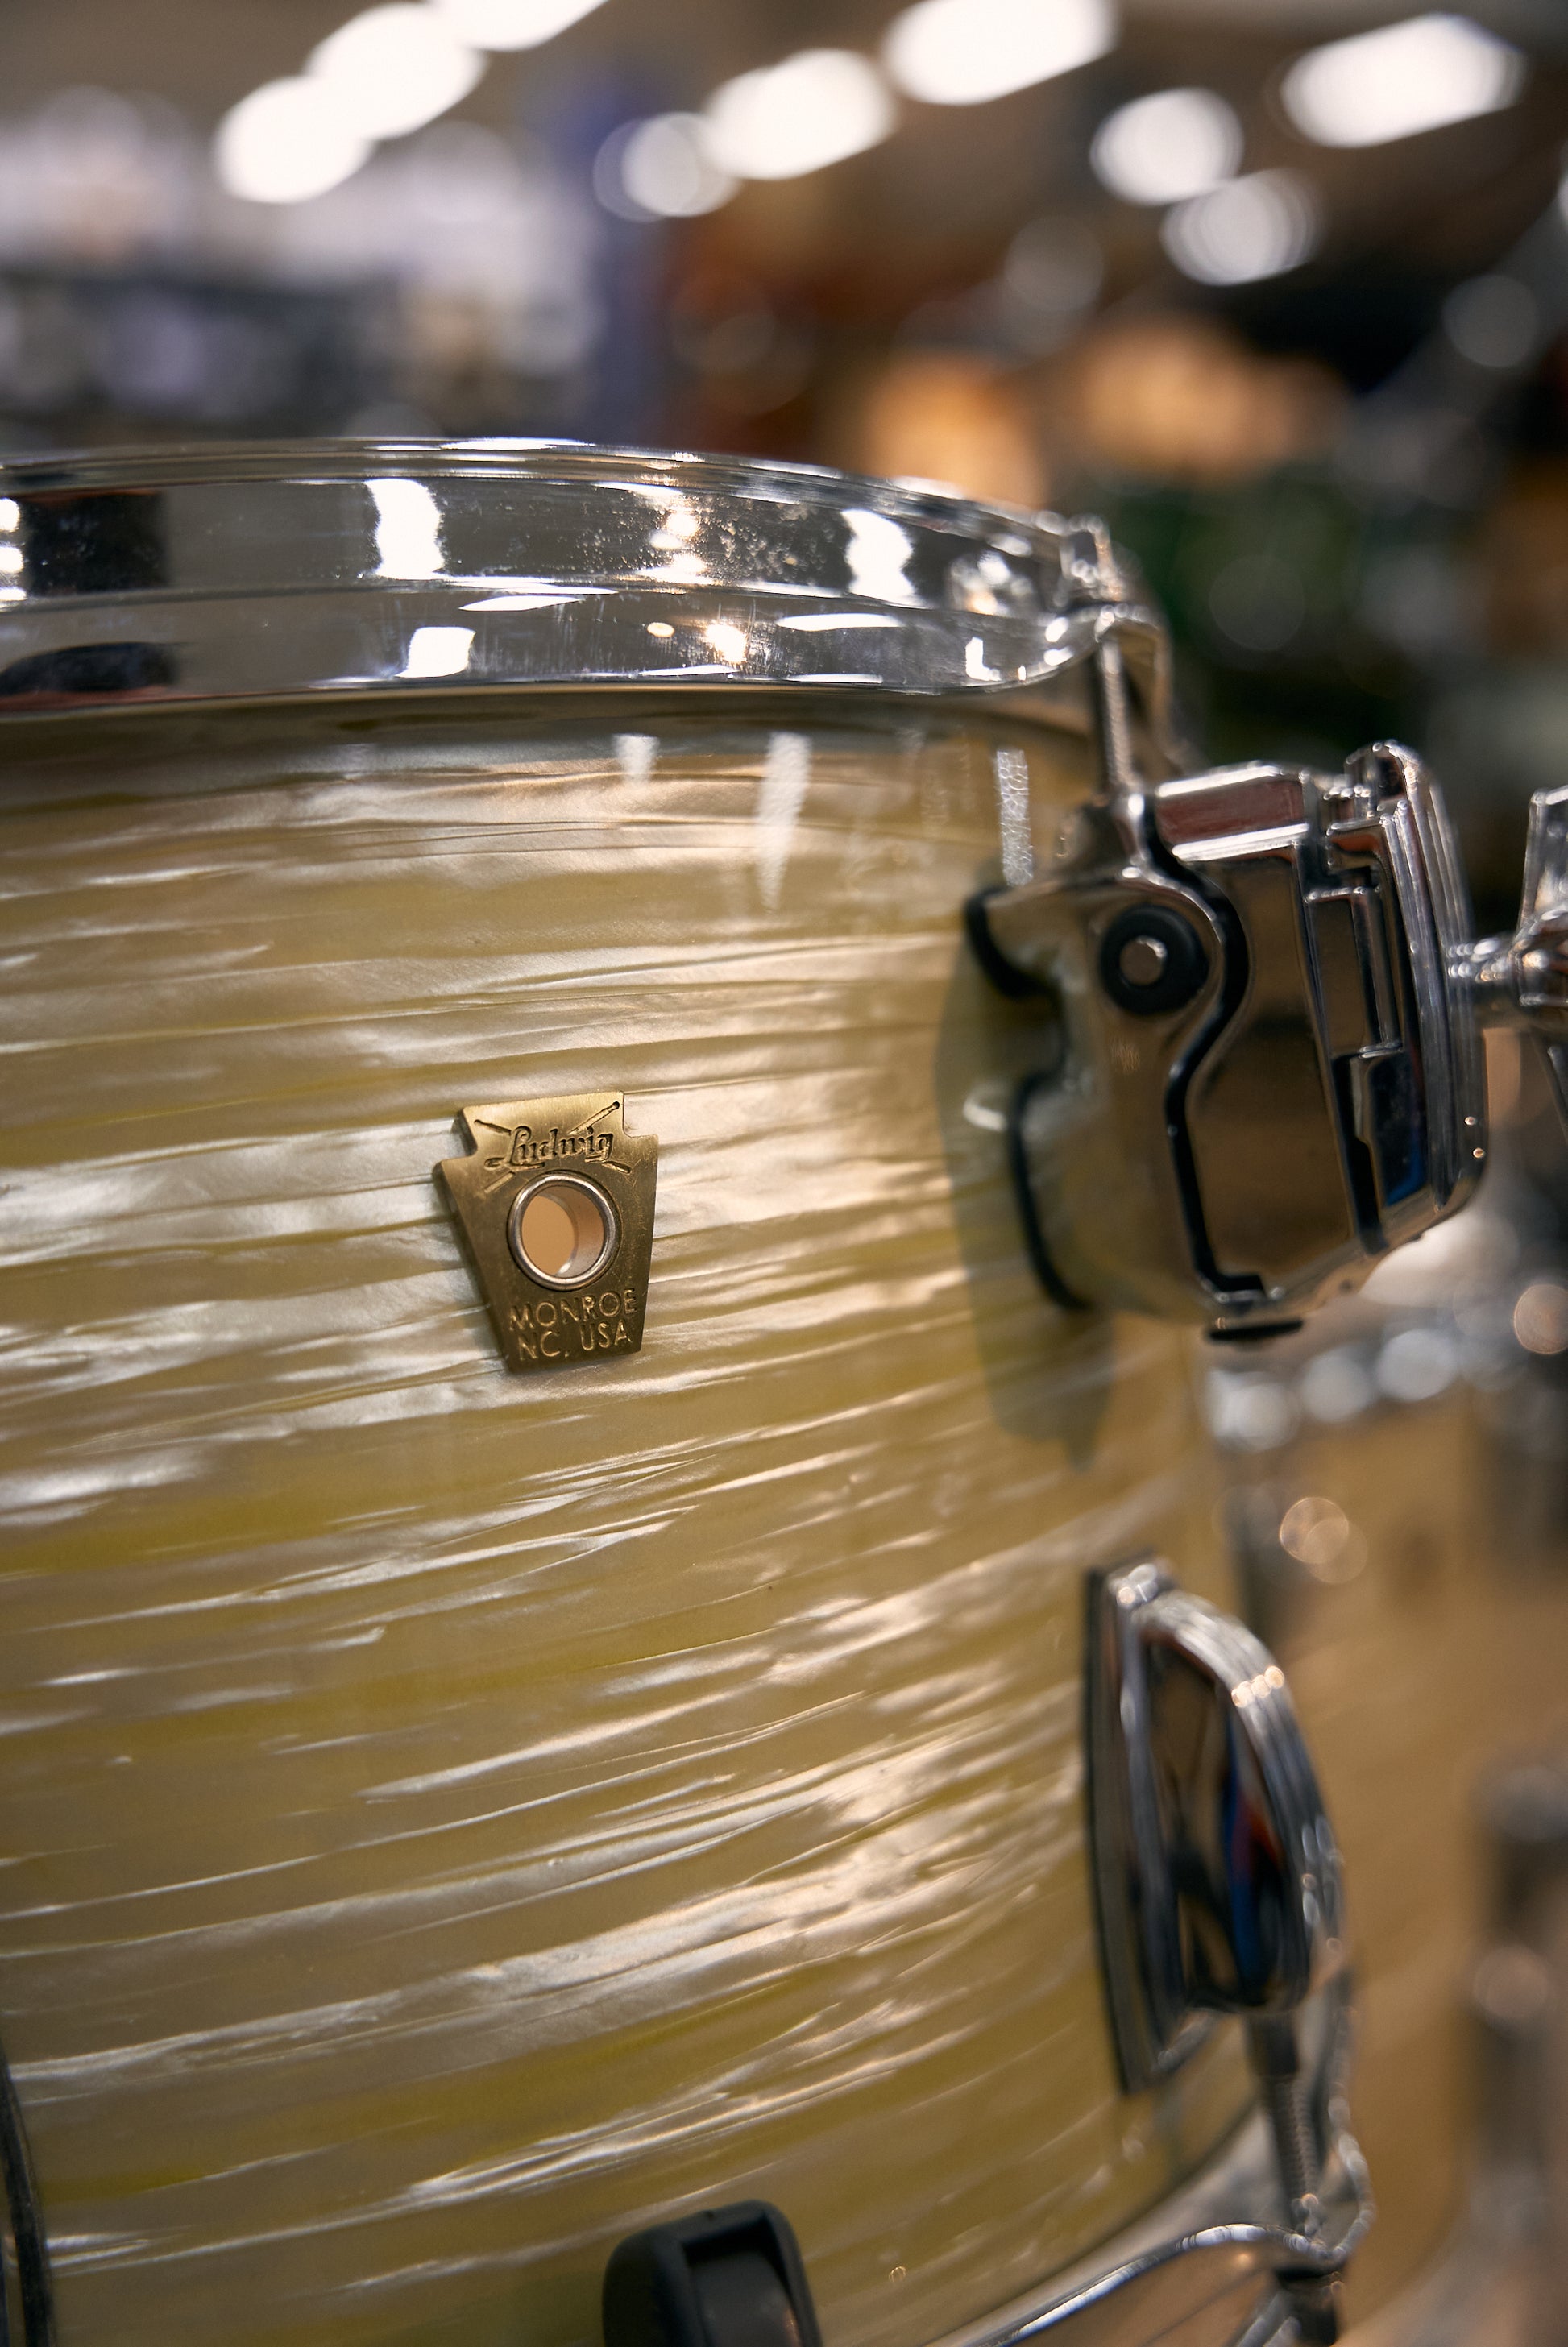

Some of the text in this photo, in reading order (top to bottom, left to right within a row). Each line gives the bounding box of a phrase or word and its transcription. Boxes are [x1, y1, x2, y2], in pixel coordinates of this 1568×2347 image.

[485, 1125, 614, 1168] Ludwig
[509, 1288, 637, 1330] MONROE
[580, 1320, 633, 1350] USA
